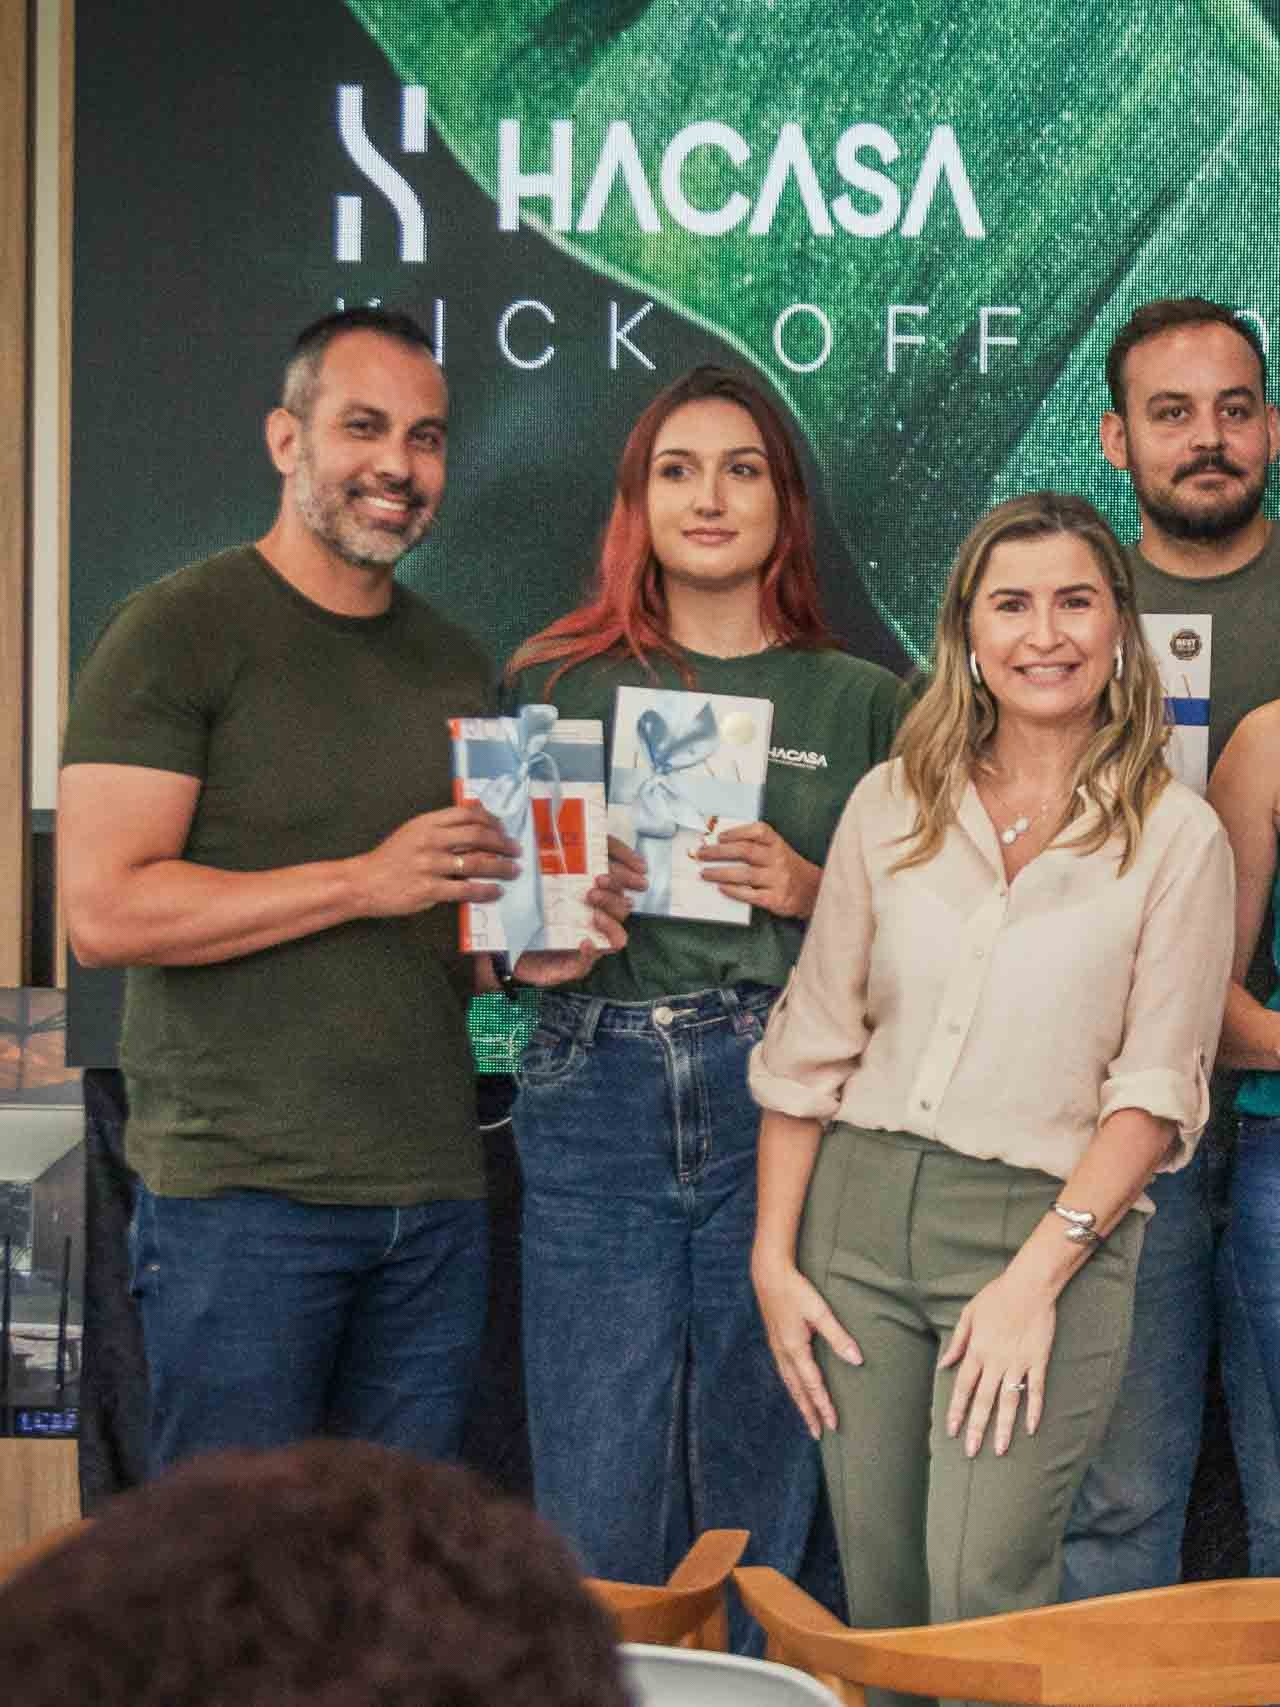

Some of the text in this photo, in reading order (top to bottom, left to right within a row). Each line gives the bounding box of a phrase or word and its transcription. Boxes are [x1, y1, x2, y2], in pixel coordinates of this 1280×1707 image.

[498, 118, 987, 240] HACASA
[336, 298, 657, 370] ICK
[773, 303, 1022, 374] OFF
